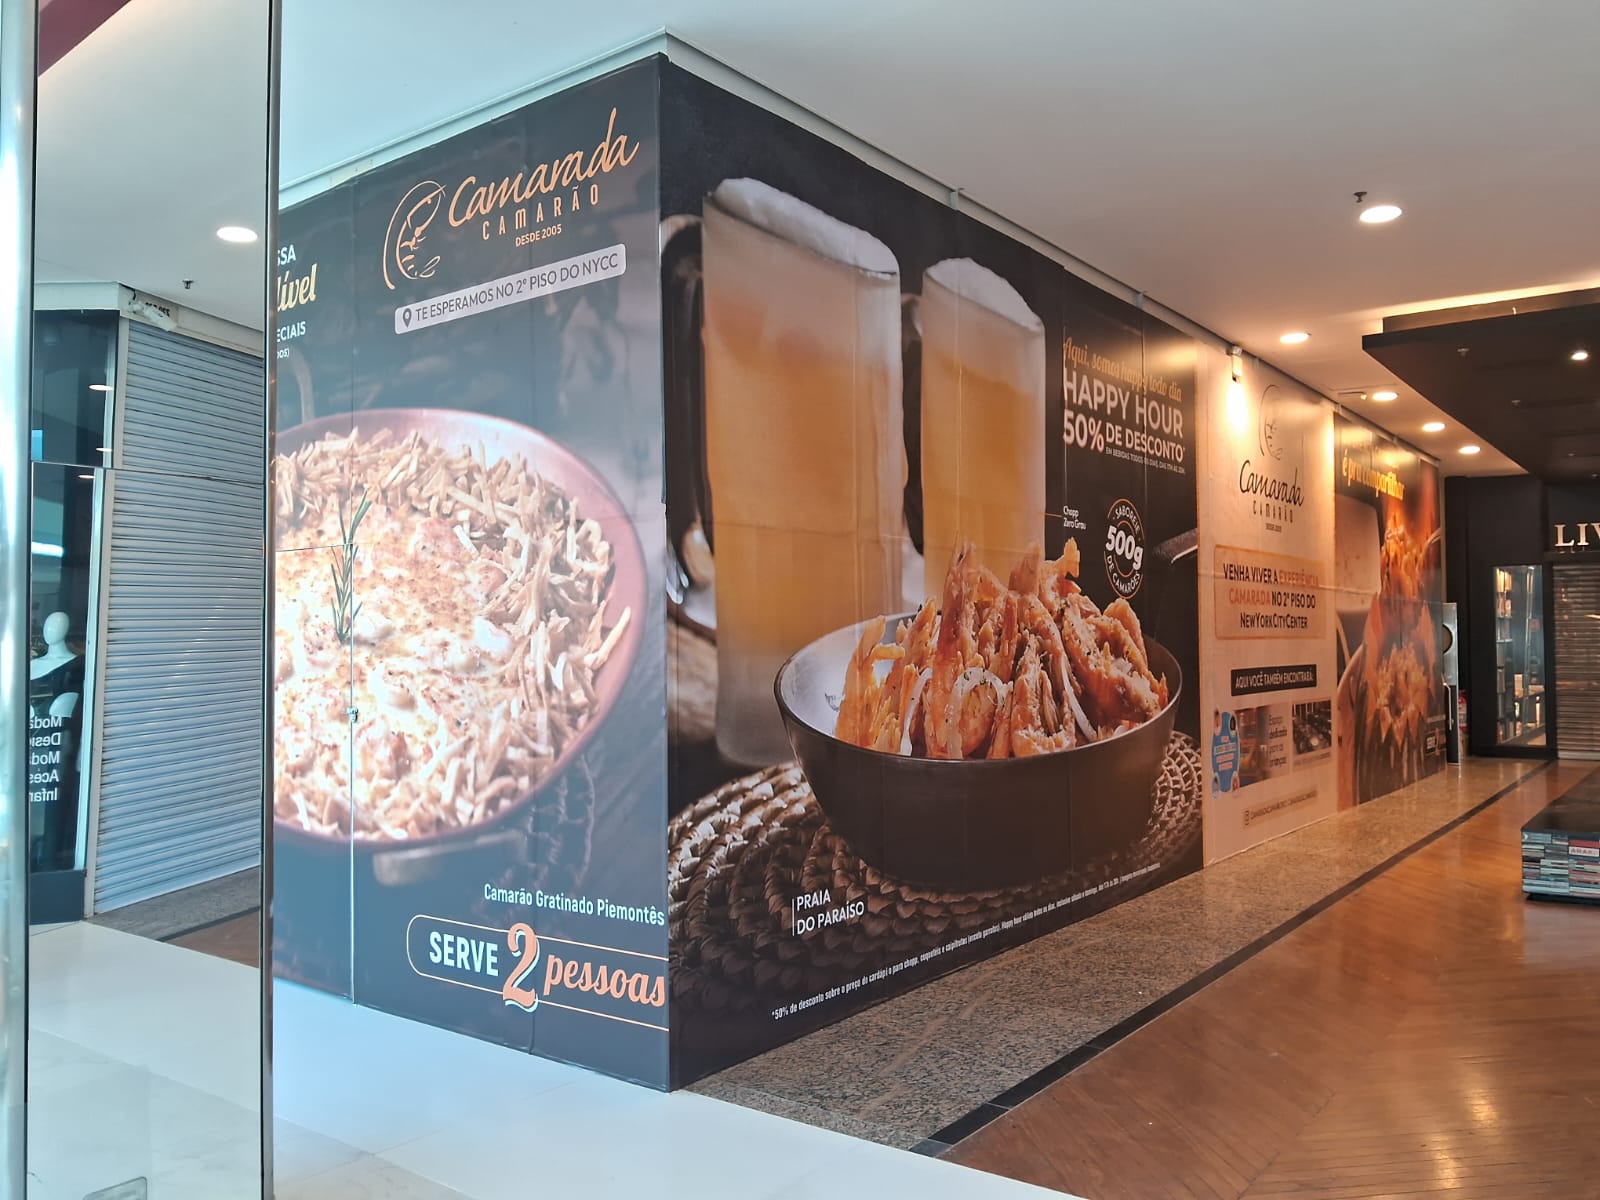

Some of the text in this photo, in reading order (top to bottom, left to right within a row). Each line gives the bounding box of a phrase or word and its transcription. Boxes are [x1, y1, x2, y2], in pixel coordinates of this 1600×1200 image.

[447, 106, 640, 228] Camarada
[482, 184, 599, 240] CAMARÃO
[515, 223, 562, 248] DESDE 2005
[415, 306, 429, 322] TE
[430, 287, 494, 319] ESPERAMOS
[496, 281, 514, 301] NO
[529, 270, 557, 291] PISO
[560, 263, 580, 282] DO
[582, 252, 619, 276] NYCC
[1063, 367, 1184, 439] HAPPY HOUR
[1062, 408, 1105, 454] 50%
[1105, 422, 1123, 447] DE
[1239, 459, 1305, 508] Camarada
[1105, 525, 1144, 571] 500g
[1223, 563, 1250, 582] VENHA
[1251, 566, 1273, 585] VIVER
[1273, 569, 1279, 585] A
[1229, 587, 1271, 606] CAMARADA
[1271, 591, 1282, 607] NO
[1290, 592, 1306, 609] PISO
[1306, 594, 1317, 609] DO
[1235, 675, 1249, 689] AQUI
[1249, 670, 1264, 687] VOCÊ
[483, 883, 665, 927] Camarão Gratinado Piemontês
[796, 888, 832, 912] PRAIA
[797, 900, 865, 935] DO PARAÍSO
[429, 922, 666, 1013] SERVE 2 pessoas
[789, 1002, 798, 1014] de
[798, 993, 825, 1011] desconto
[825, 986, 841, 1001] sobre
[845, 978, 862, 994] preço
